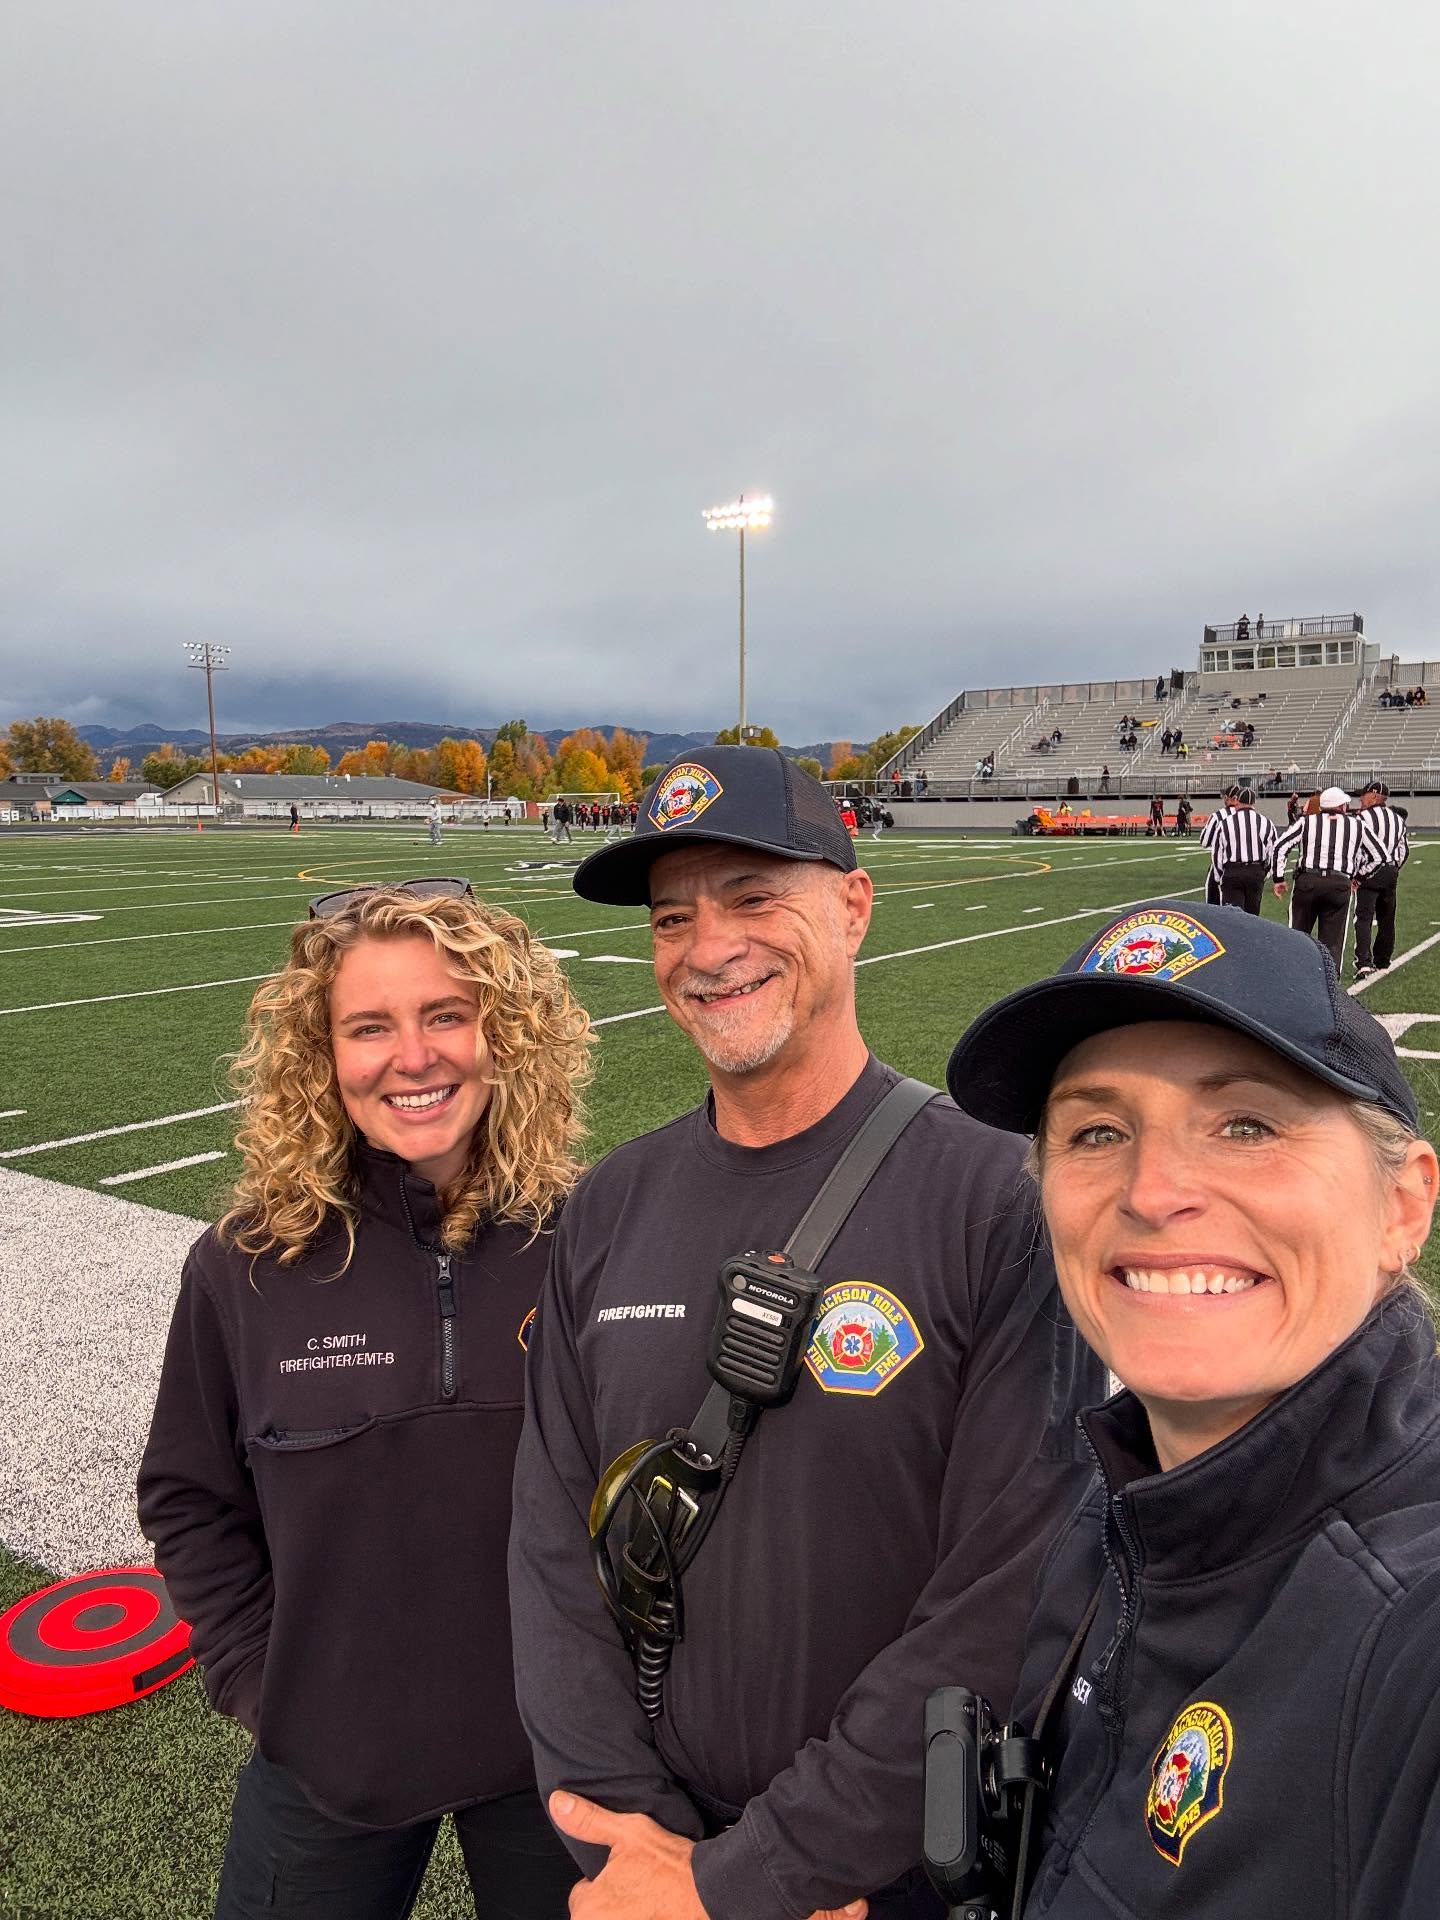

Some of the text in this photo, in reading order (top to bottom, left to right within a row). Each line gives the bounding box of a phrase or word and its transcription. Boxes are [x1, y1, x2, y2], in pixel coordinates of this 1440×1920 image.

[1098, 914, 1202, 955] JACKSON HOLE
[748, 1284, 794, 1305] MOTOROLA
[597, 1304, 686, 1322] FIREFIGHTER
[871, 1293, 903, 1326] HOLE
[307, 1333, 367, 1351] C. SMITH
[279, 1352, 395, 1374] FIREFIGHTER/EMT-B
[807, 1345, 828, 1373] FIRE
[875, 1351, 901, 1377] EMS
